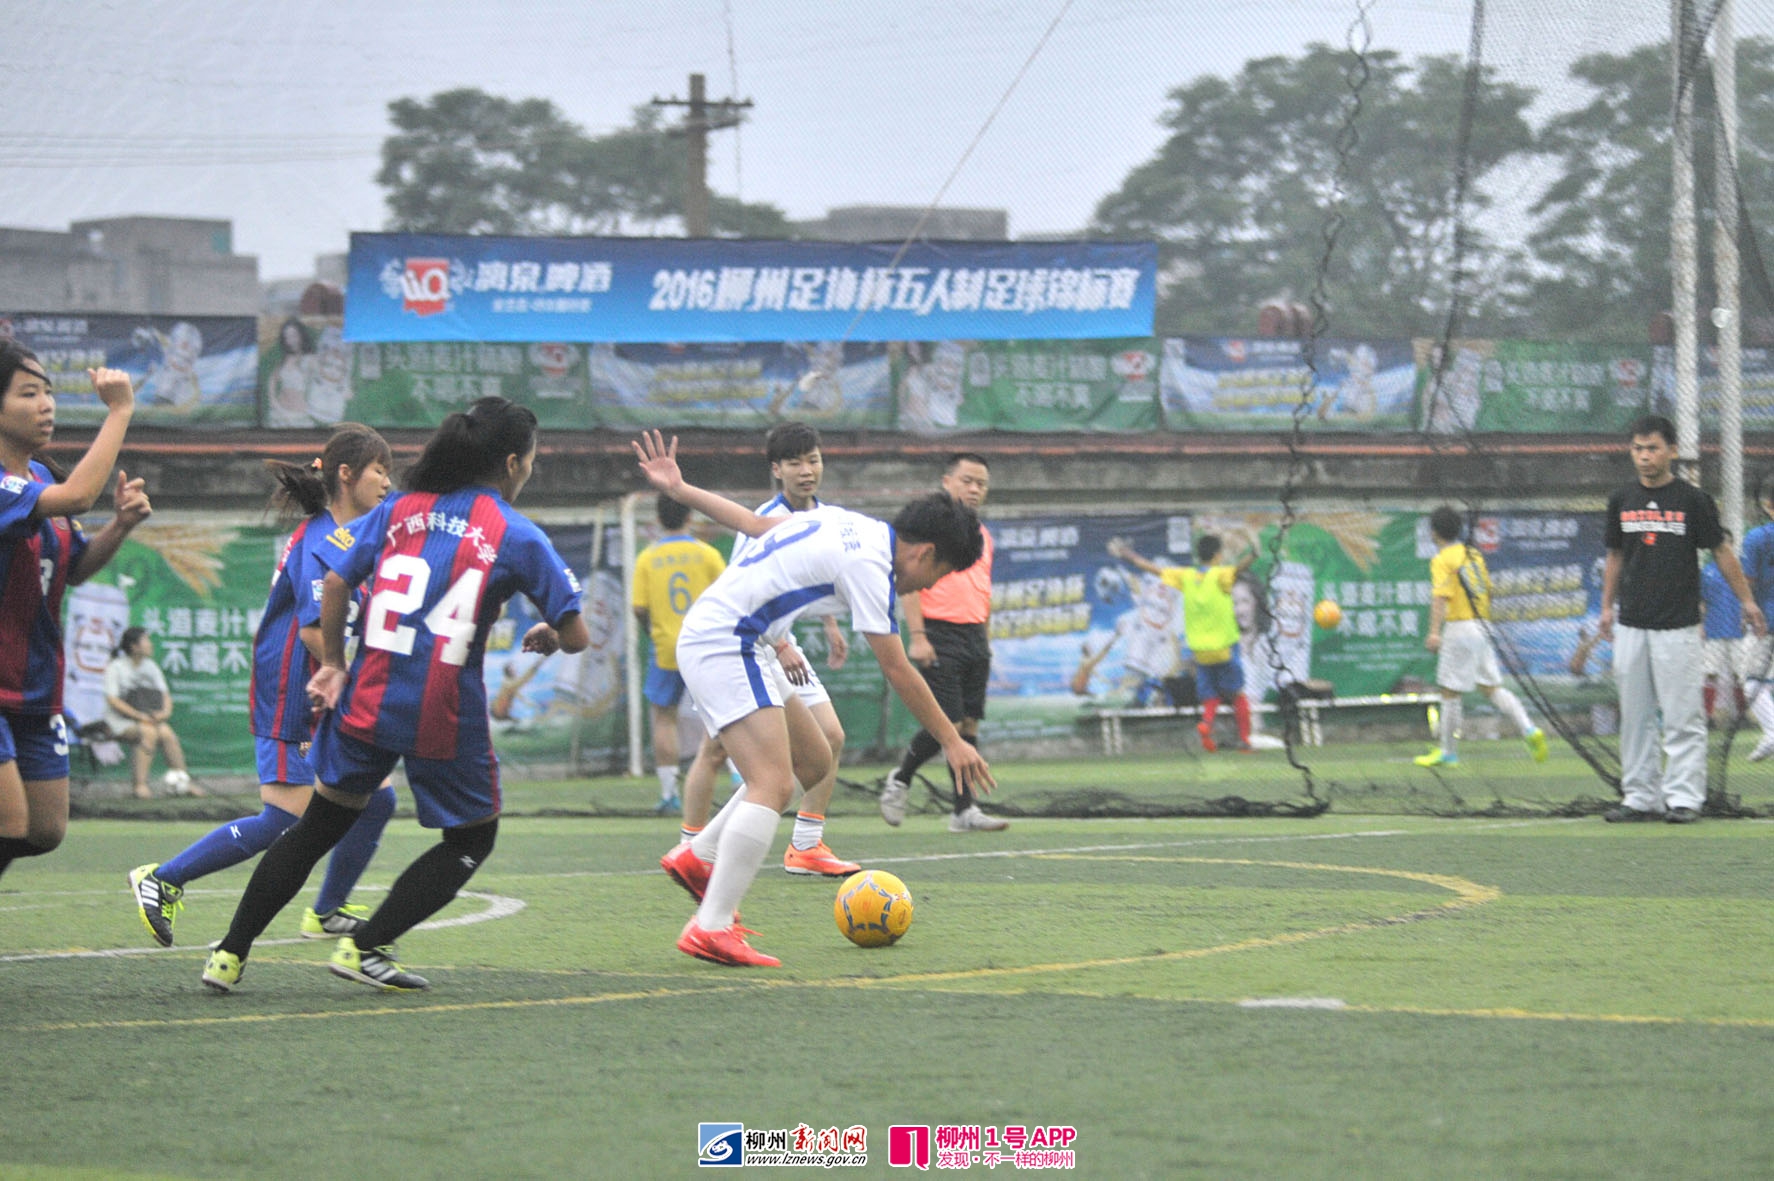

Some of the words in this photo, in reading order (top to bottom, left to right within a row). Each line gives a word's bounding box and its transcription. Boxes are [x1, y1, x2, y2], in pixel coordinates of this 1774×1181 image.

[386, 511, 499, 565] 广西科技大学
[364, 553, 484, 667] 24
[667, 571, 692, 615] 6
